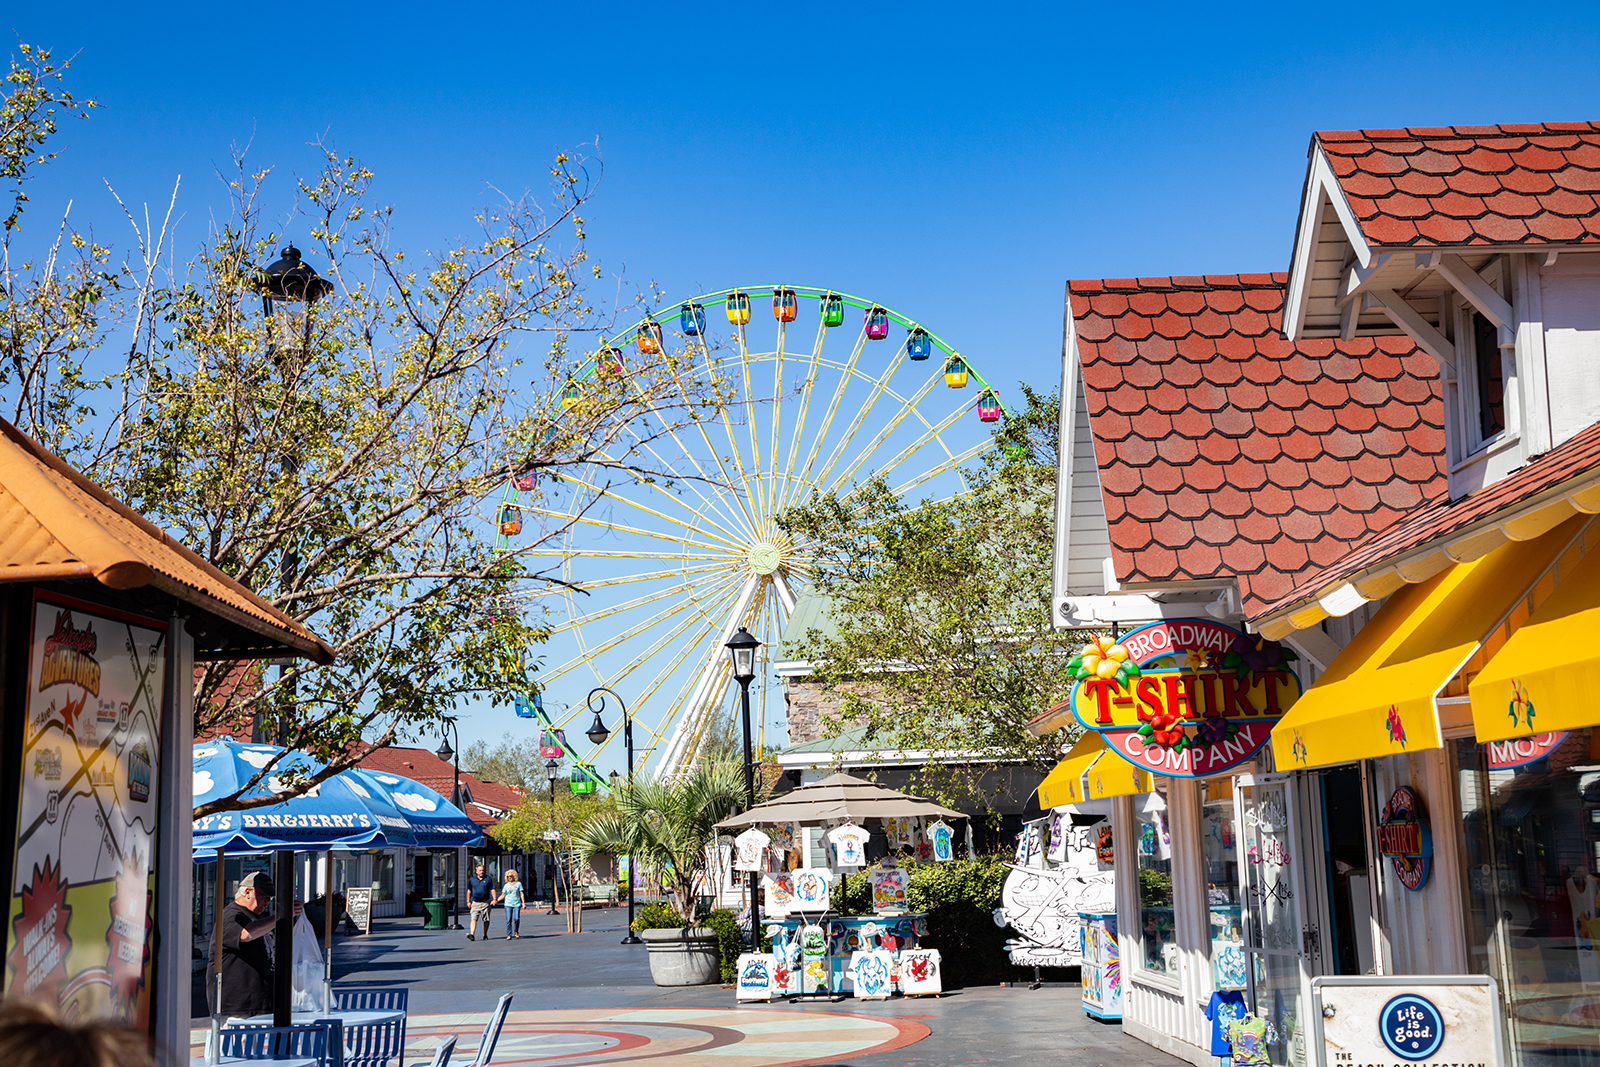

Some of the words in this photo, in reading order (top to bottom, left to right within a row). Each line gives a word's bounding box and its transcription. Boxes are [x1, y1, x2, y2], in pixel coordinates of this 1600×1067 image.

[45, 609, 97, 656] Helicopter
[1126, 625, 1235, 660] BROADWAY
[39, 648, 101, 698] ADVENTURES
[1084, 671, 1289, 723] T-SHIRT
[1124, 724, 1257, 771] COMPANY
[242, 812, 371, 828] BEN&JERRY'S
[285, 829, 307, 837] LOVE
[330, 829, 358, 837] CREAM
[1376, 825, 1418, 853] T-SHIRT
[1473, 876, 1517, 893] BEACH
[23, 903, 58, 958] WALK-INS
[26, 927, 56, 976] ALWAYS
[1397, 1006, 1424, 1021] Life
[1407, 1020, 1420, 1029] is
[1395, 1026, 1433, 1043] good.
[1335, 1052, 1353, 1061] THE
